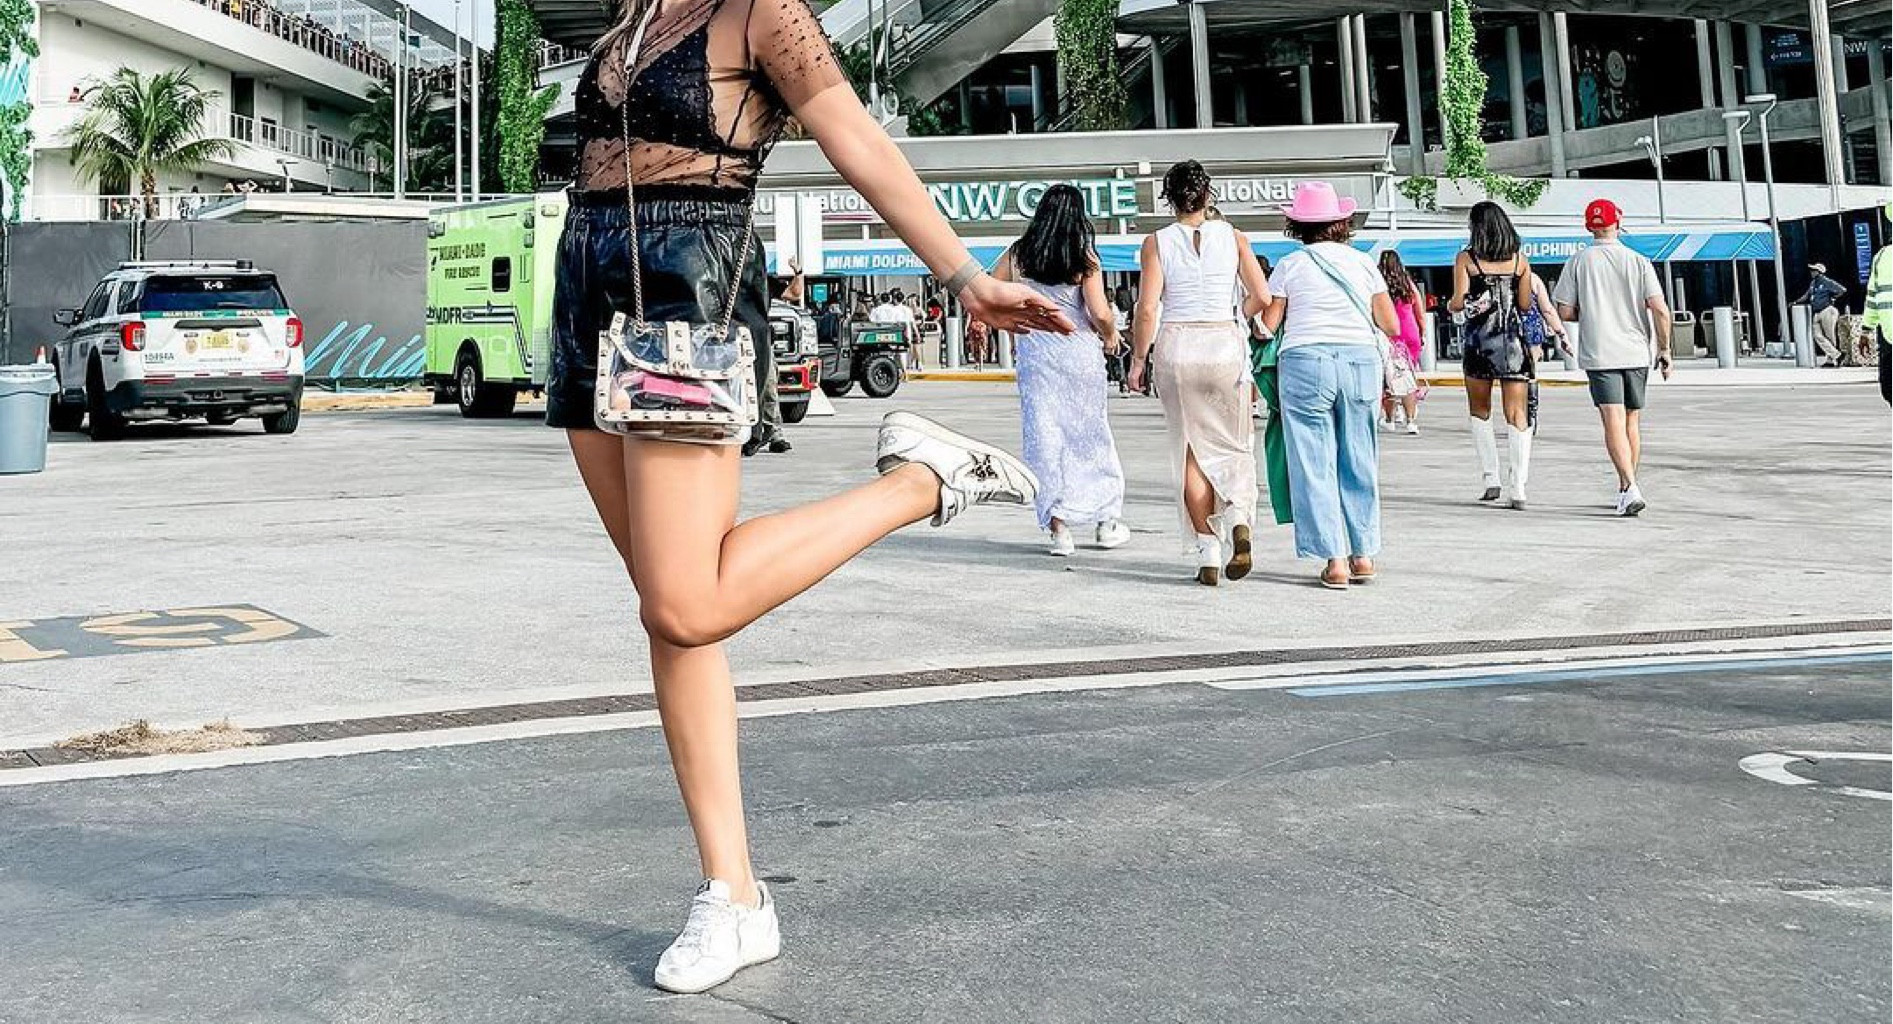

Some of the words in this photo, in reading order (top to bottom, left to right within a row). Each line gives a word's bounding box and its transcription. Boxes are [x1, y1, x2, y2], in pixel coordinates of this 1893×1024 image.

[928, 182, 1009, 220] NW
[1018, 179, 1139, 218] GTE
[1523, 242, 1587, 258] OLPHINS
[826, 255, 868, 269] MIAMI
